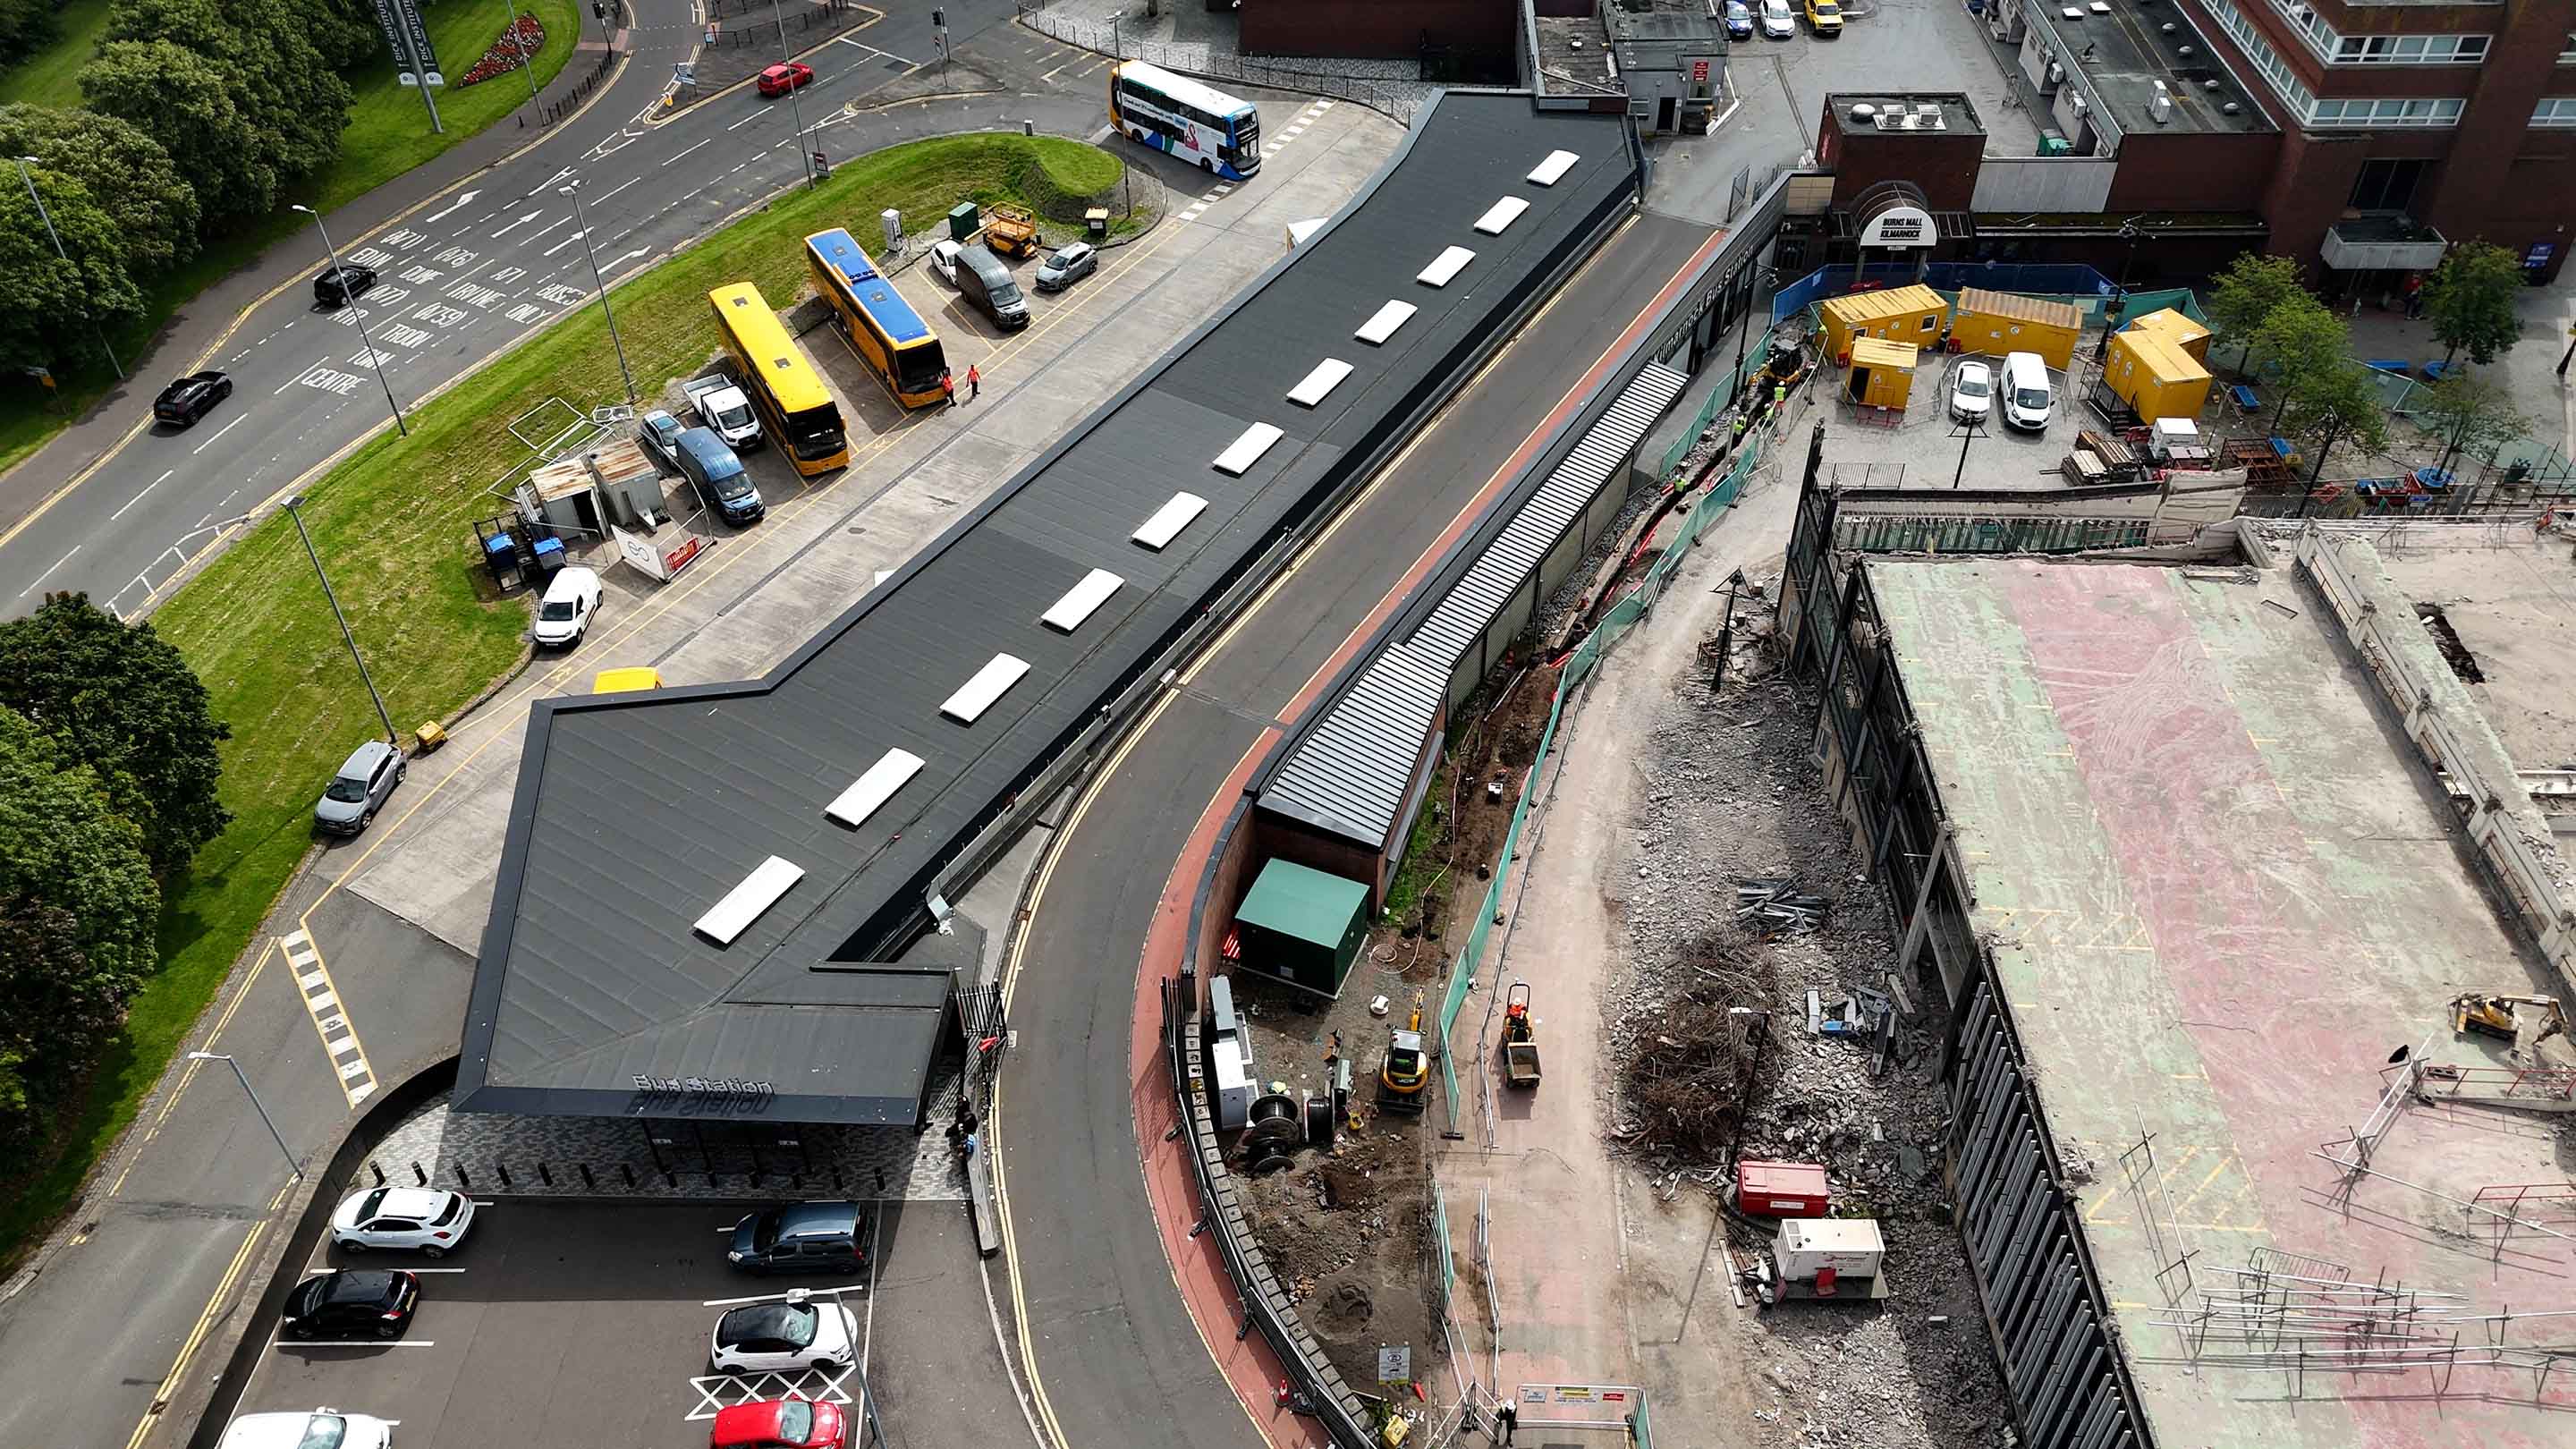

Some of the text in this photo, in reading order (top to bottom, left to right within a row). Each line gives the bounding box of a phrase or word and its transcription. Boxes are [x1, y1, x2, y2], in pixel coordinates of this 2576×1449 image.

[377, 0, 396, 40] INSTITUTE
[403, 0, 423, 39] INSTITUTE
[391, 42, 402, 62] DICK
[417, 41, 429, 61] DICK
[1883, 217, 1923, 226] BURNS MALL
[1879, 230, 1921, 238] KILMARNOCK
[347, 247, 394, 268] EDIN
[489, 267, 528, 284] A71
[445, 282, 507, 309] IRVINE
[535, 283, 587, 307] BUSES
[1655, 245, 1754, 362] Kilmarnock Bus Station
[326, 307, 369, 326] AYR
[505, 302, 552, 326] ONLY
[379, 323, 434, 349] TROON
[346, 345, 396, 369] TOWN
[301, 368, 368, 395] CENTRE
[632, 1074, 775, 1095] Bus Station
